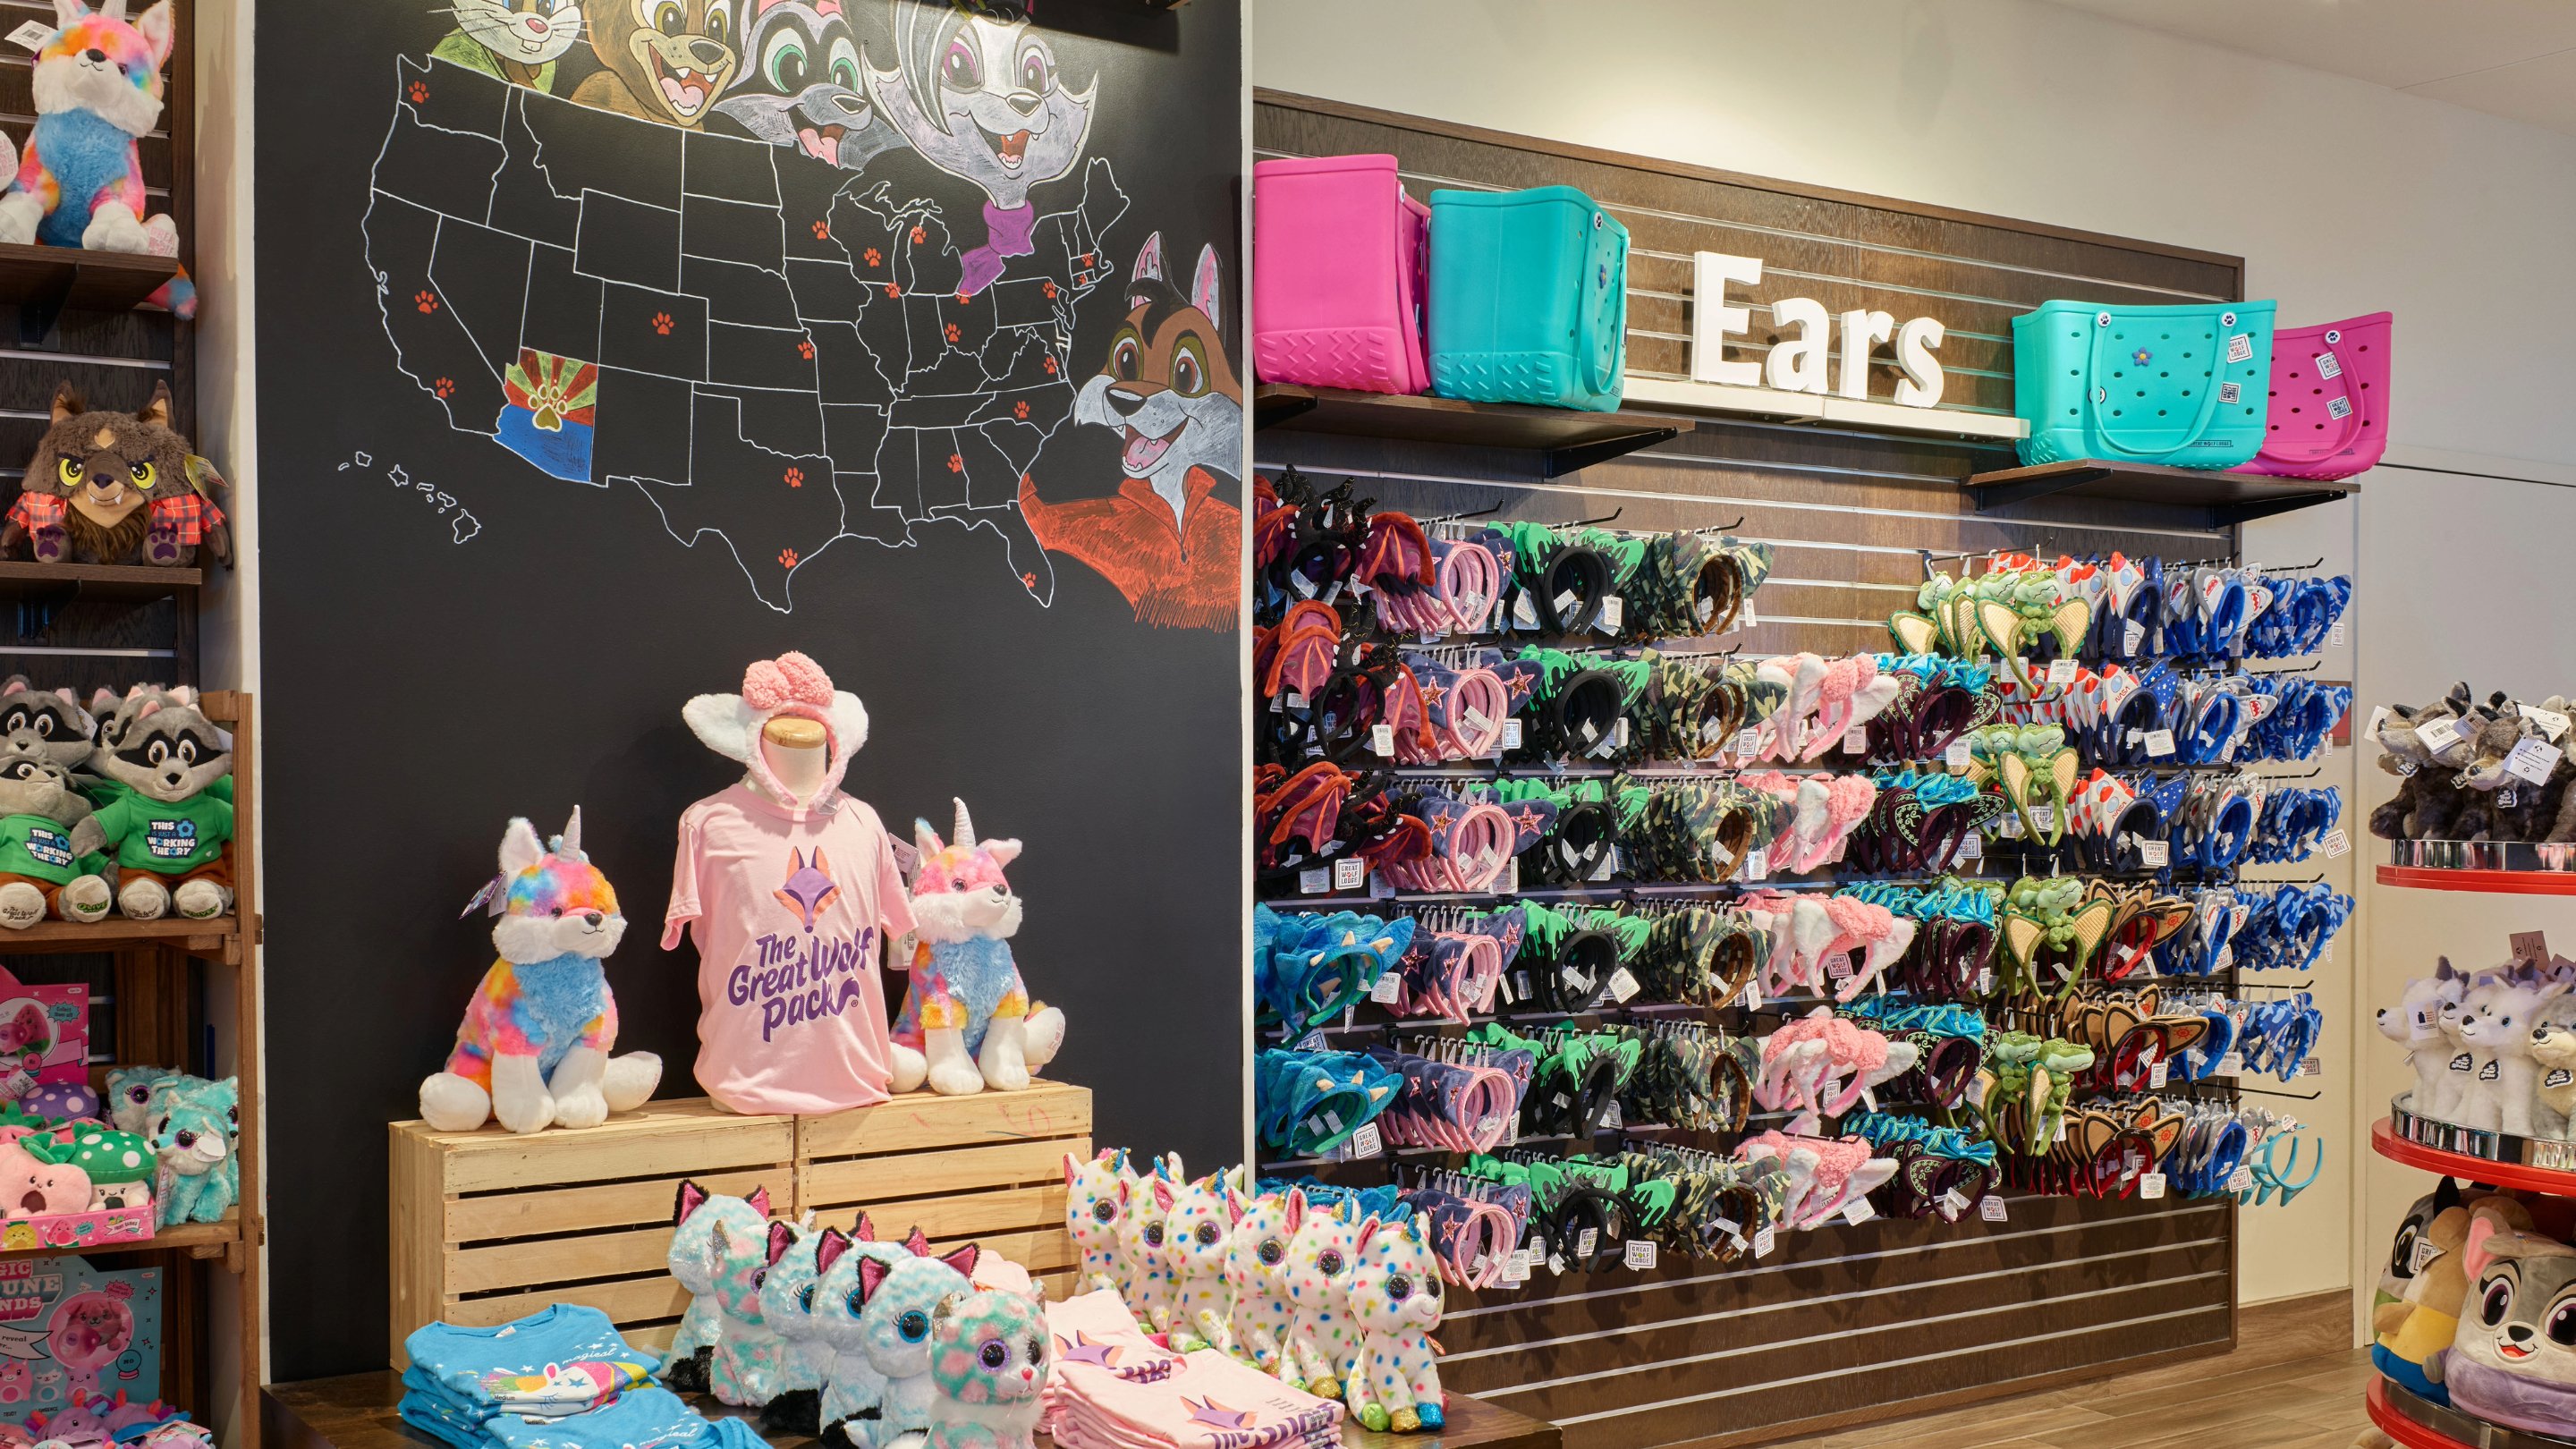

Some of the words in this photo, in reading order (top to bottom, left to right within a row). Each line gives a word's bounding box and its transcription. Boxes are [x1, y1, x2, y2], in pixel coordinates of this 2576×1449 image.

[1690, 250, 1945, 409] Ears
[2115, 686, 2131, 703] NASA
[2112, 801, 2127, 819] NASA
[151, 822, 174, 830] THIS
[31, 828, 54, 840] THIS
[148, 837, 195, 848] WORKING
[26, 843, 72, 860] WORKING
[151, 845, 191, 856] THEORY
[31, 851, 68, 866] THEORY
[756, 932, 796, 968] The
[727, 952, 809, 1006] Great
[811, 926, 875, 982] Wolf
[1359, 1131, 1374, 1140] GREAT
[1360, 1138, 1375, 1146] WOLF
[1360, 1144, 1377, 1152] LODGE
[563, 1347, 617, 1364] magical
[1310, 1412, 1327, 1422] Small
[640, 1428, 698, 1446] magical
